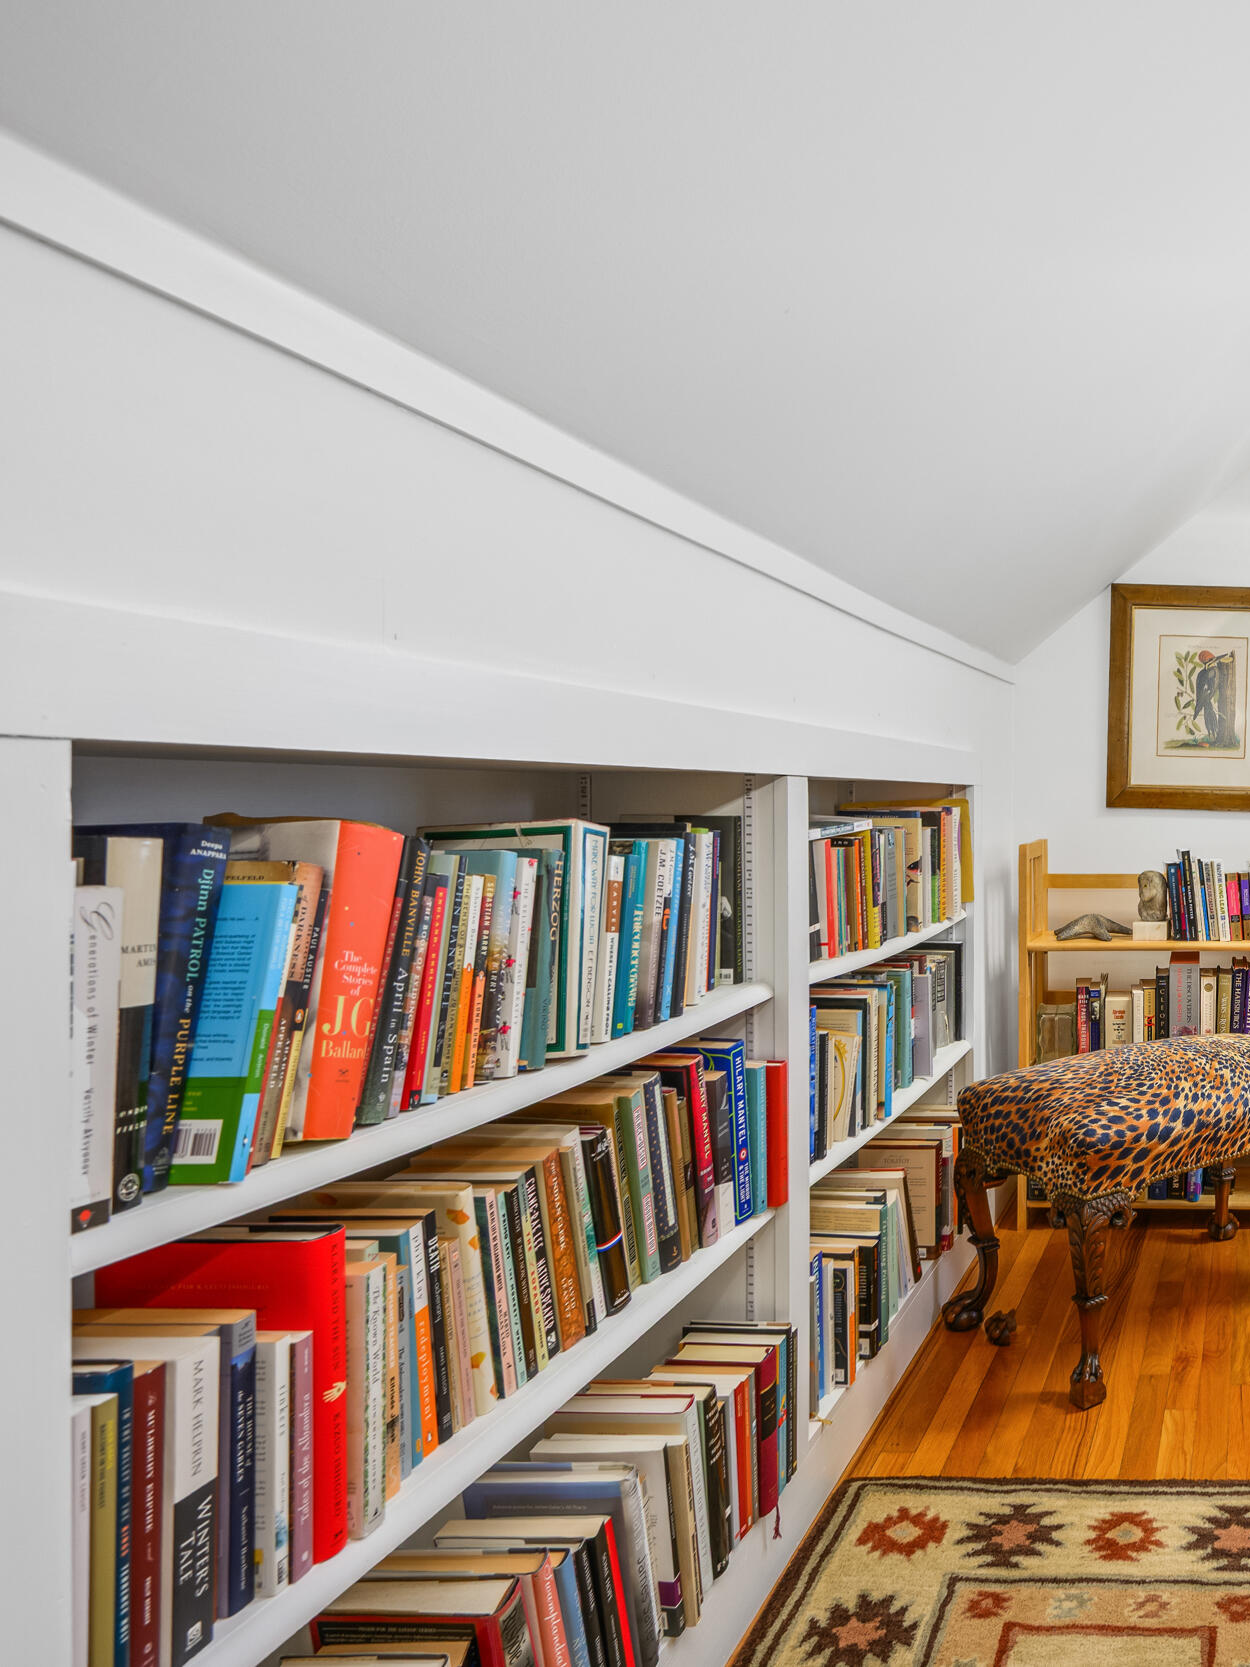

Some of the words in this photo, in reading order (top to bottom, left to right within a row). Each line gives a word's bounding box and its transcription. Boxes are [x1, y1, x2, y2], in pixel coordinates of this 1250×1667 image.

[201, 840, 223, 850] Deepa
[413, 850, 428, 885] JOHN
[197, 868, 215, 912] Djinn
[550, 859, 564, 942] HERZOG
[610, 882, 620, 933] CARVER
[654, 873, 666, 918] COETZEE
[311, 926, 321, 953] PAUL
[400, 889, 420, 957] BANVILLE
[481, 929, 490, 957] BARRY
[186, 917, 206, 983] PATROL
[334, 960, 378, 976] Complete
[343, 951, 363, 962] The
[302, 955, 317, 990] AUSTER
[342, 974, 374, 985] Stories
[350, 986, 361, 996] of
[391, 967, 409, 1013] April
[1235, 972, 1243, 988] THE
[390, 1018, 398, 1029] in
[1232, 989, 1242, 1029] HABSBURGS
[86, 1023, 97, 1065] Winter
[169, 1018, 191, 1088] PURPLE
[381, 1033, 399, 1084] Spain
[697, 1066, 708, 1108] HILARY
[734, 1055, 746, 1098] HILARY
[161, 1093, 180, 1135] LINE
[700, 1111, 711, 1159] MANTEL
[735, 1099, 747, 1145] MANTEL
[552, 1176, 561, 1217] INDIAN
[428, 1235, 440, 1273] DEATH
[556, 1217, 567, 1251] CLERK
[537, 1257, 550, 1286] NATIVE
[542, 1287, 556, 1330] SPEAKER
[560, 1277, 572, 1320] LEAVITT
[567, 1277, 577, 1310] DAVID
[371, 1306, 381, 1345] Known
[192, 1359, 205, 1409] MARK
[371, 1348, 382, 1384] World
[418, 1320, 434, 1421] redeployment
[299, 1393, 312, 1450] Alhambra
[191, 1413, 203, 1477] HELPRIN
[300, 1454, 312, 1475] the
[299, 1499, 312, 1525] Tales
[179, 1530, 196, 1585] TALE
[194, 1494, 213, 1597] WINTER'S
